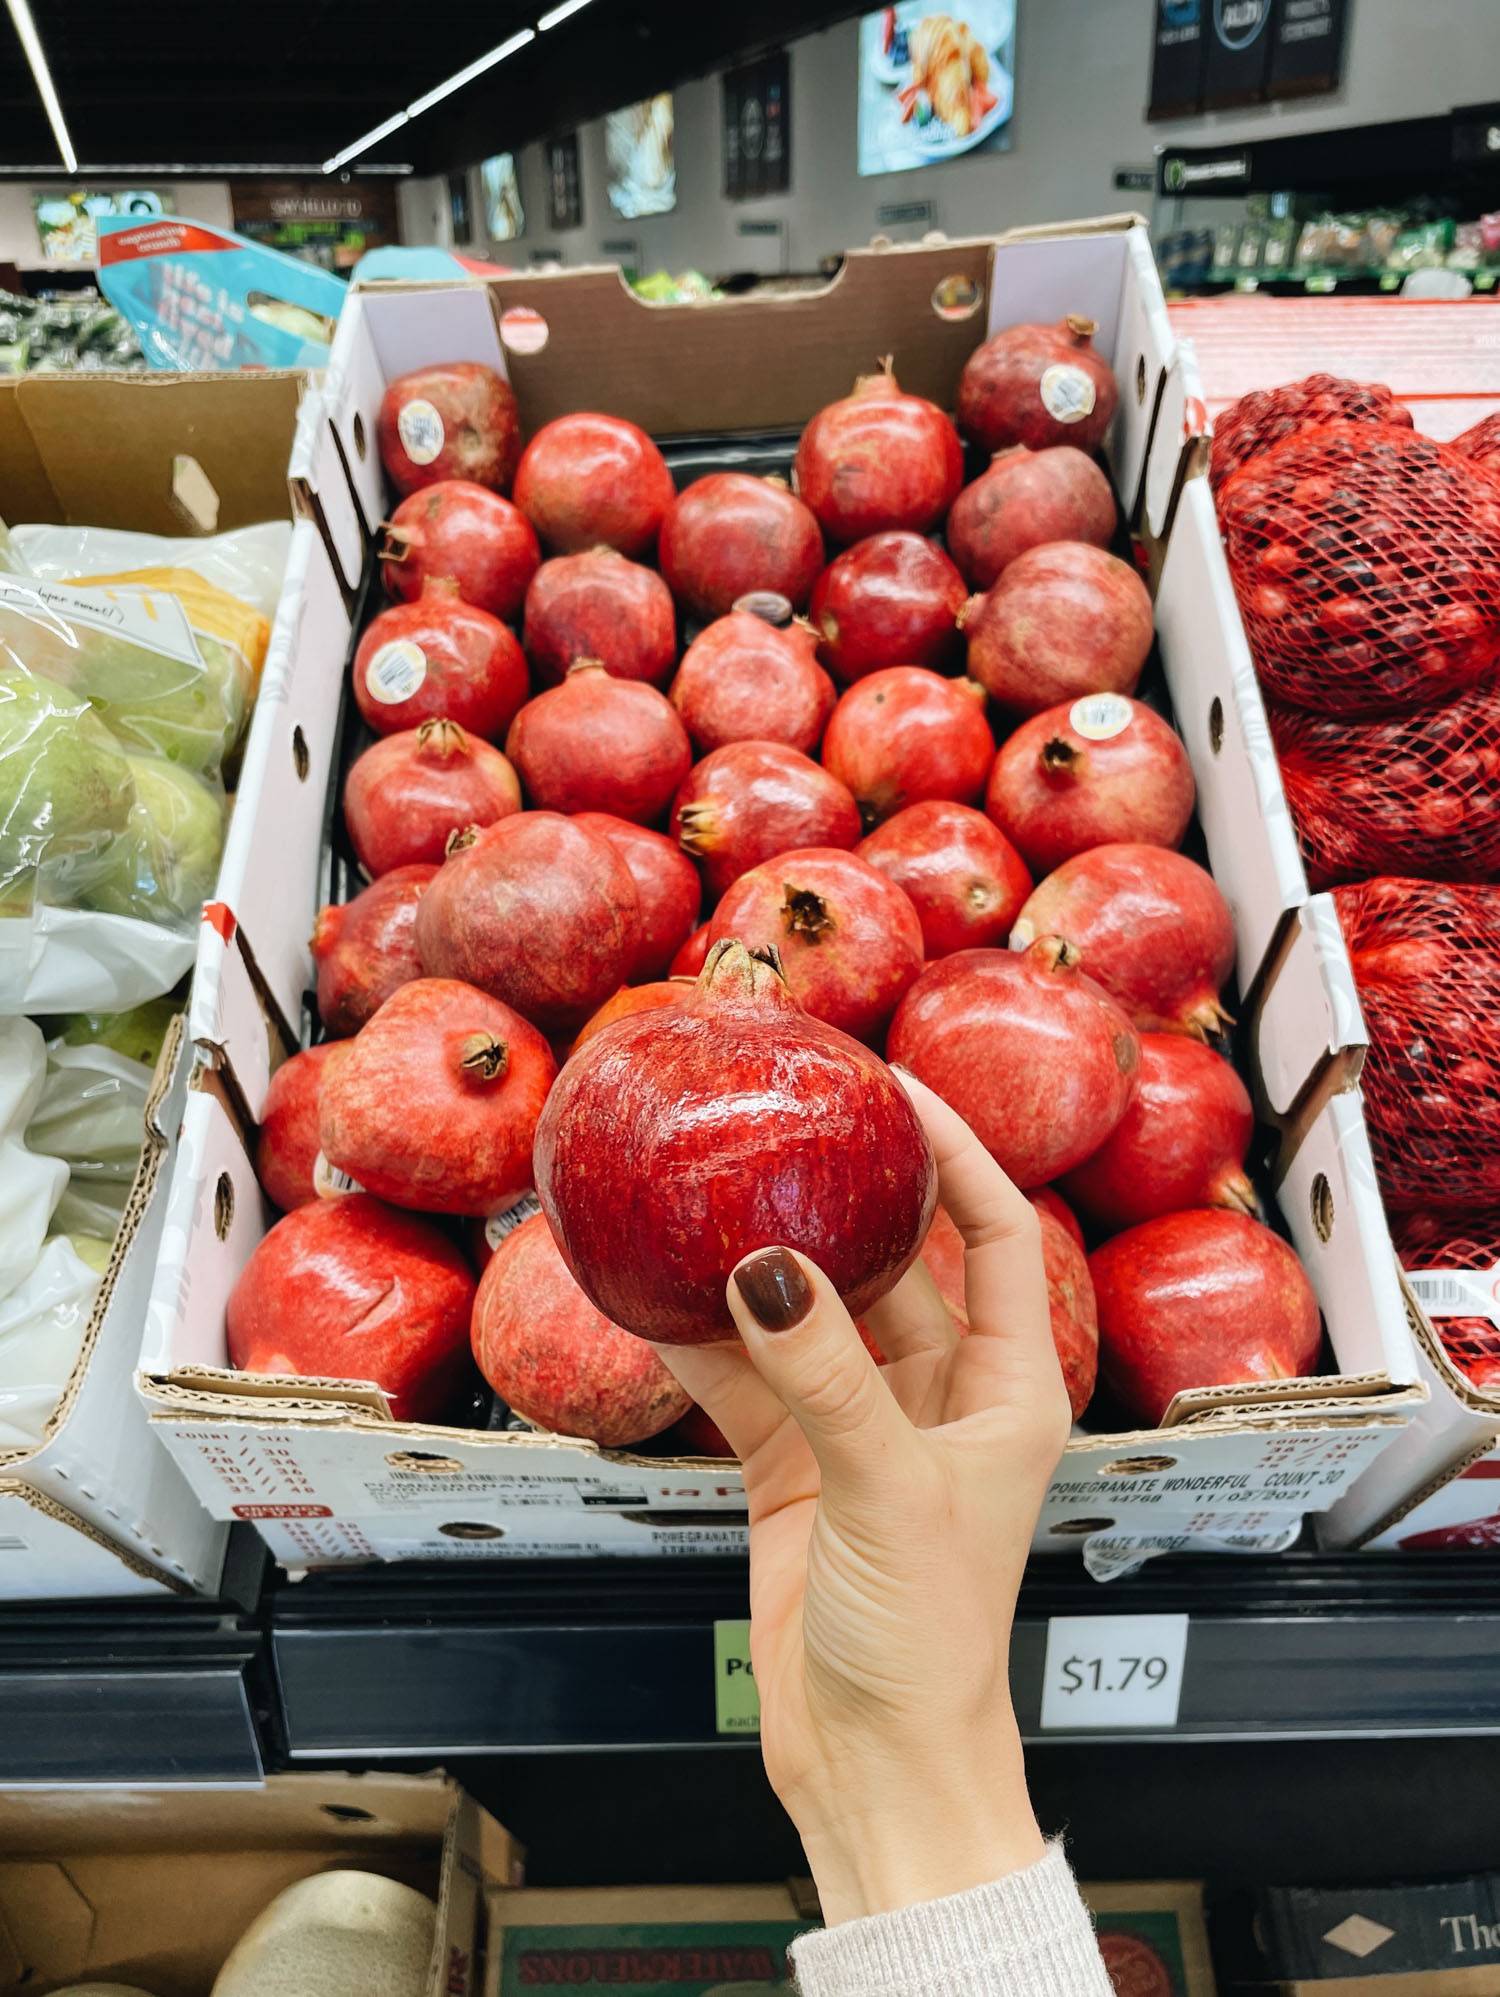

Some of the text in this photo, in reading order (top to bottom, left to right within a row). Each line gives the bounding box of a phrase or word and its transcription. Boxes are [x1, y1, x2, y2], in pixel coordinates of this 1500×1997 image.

[1049, 1469, 1345, 1494] POMEGRANATE WONDERFUL COUNT 30
[651, 1530, 746, 1543] POMEGRANATE
[1060, 1655, 1169, 1696] $1.79
